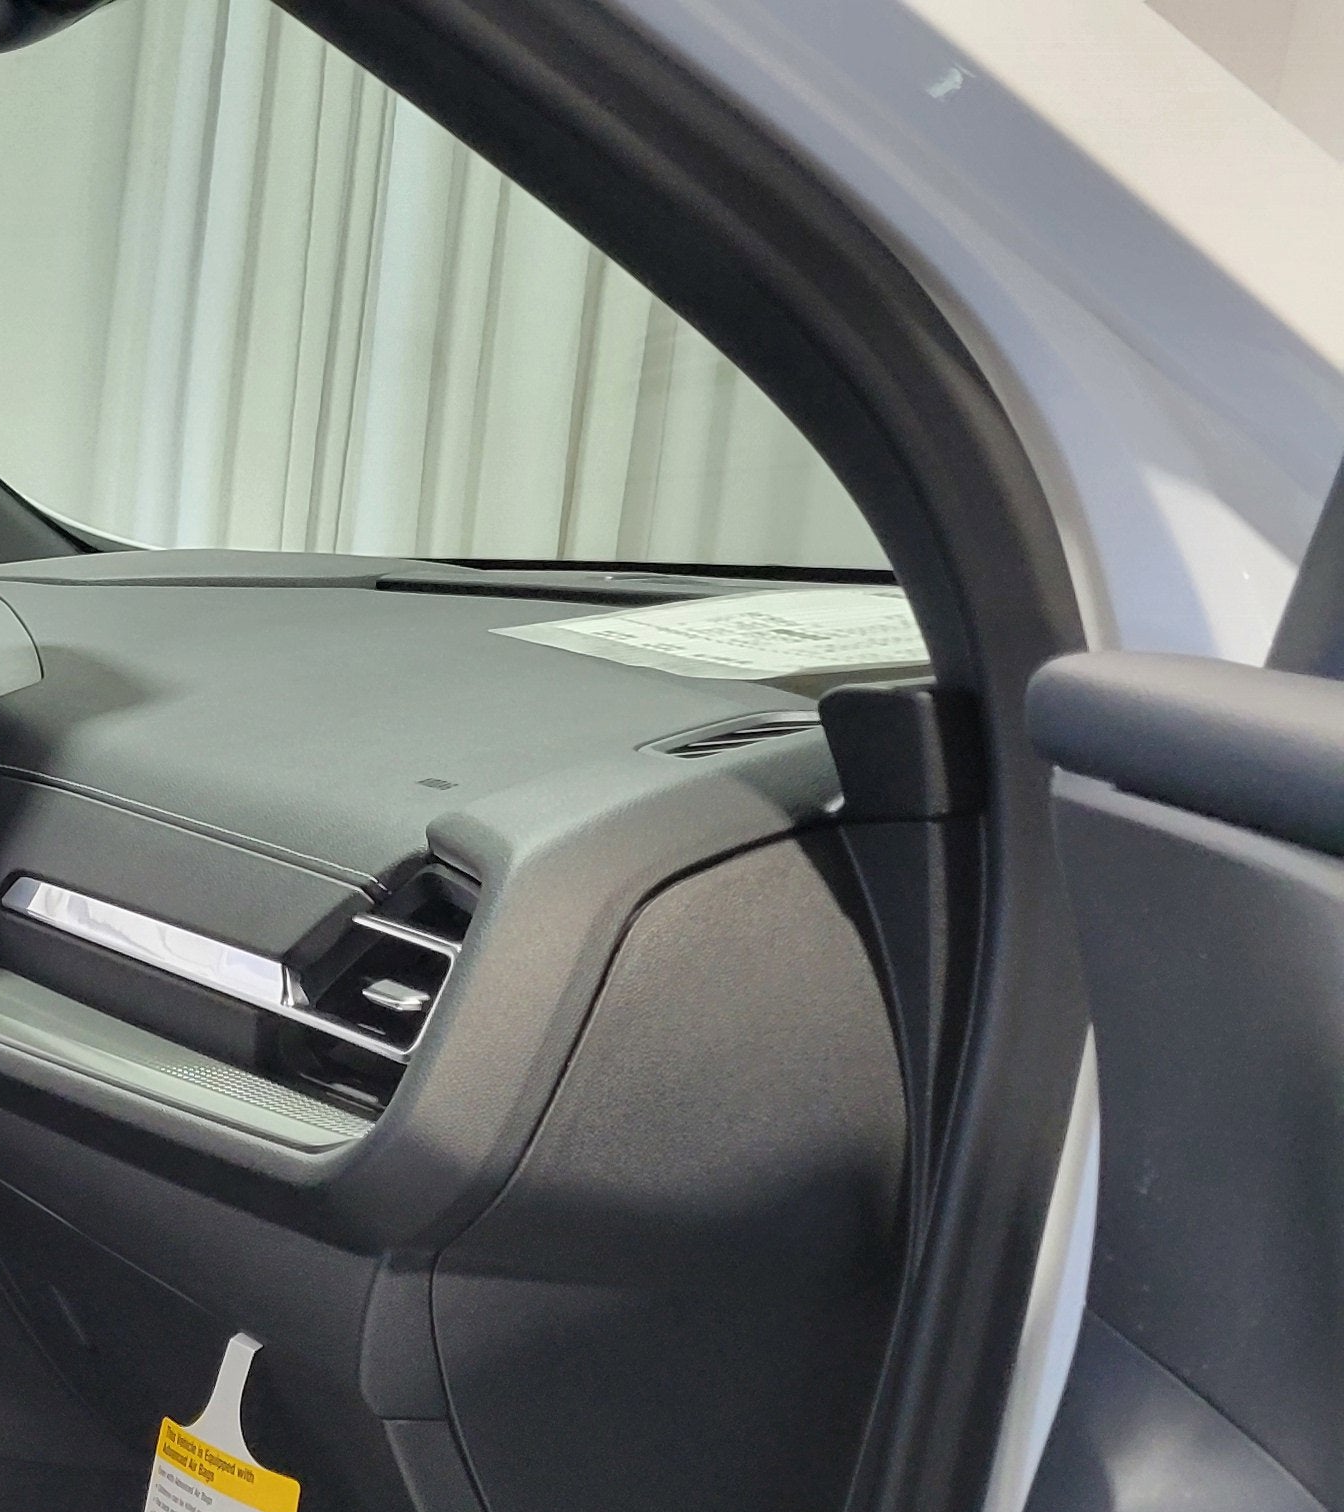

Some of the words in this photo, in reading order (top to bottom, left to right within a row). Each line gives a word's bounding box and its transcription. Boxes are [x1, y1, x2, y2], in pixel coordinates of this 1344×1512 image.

[198, 1463, 215, 1482] Bags
[205, 1449, 236, 1475] Equipped
[237, 1465, 255, 1484] with
